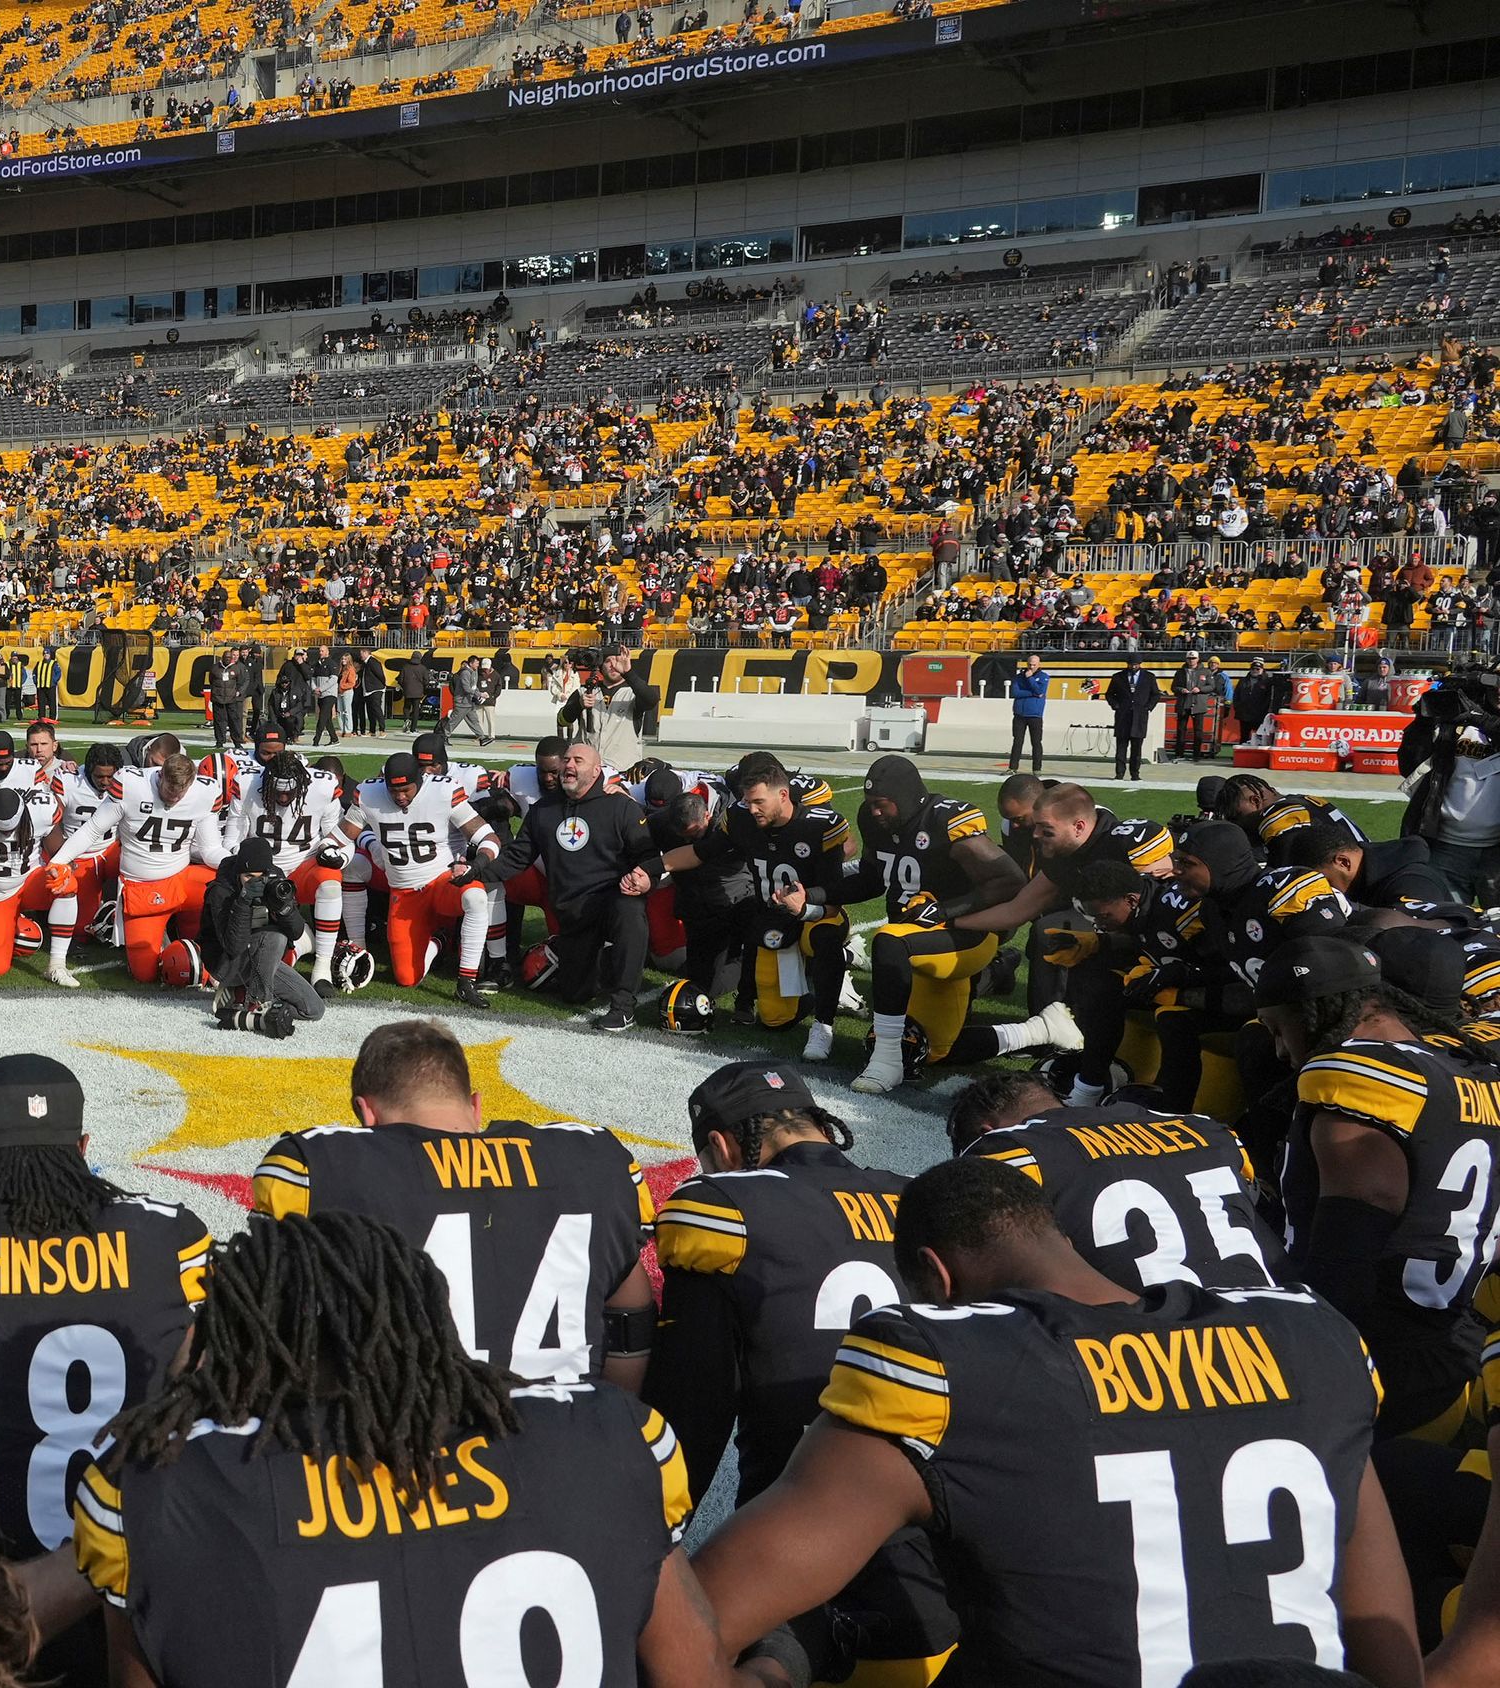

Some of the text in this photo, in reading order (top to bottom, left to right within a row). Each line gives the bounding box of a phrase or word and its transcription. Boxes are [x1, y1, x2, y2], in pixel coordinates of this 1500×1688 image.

[939, 19, 959, 30] BUILT
[939, 31, 960, 41] TOUGH
[507, 40, 826, 108] NeighborhoodFordStore.com
[868, 446, 879, 455] 90
[941, 479, 951, 489] 90
[1061, 467, 1072, 476] 90
[1196, 515, 1210, 526] 90
[1225, 514, 1237, 524] 39
[475, 577, 487, 587] 58
[645, 578, 656, 588] 16
[610, 614, 622, 624] 43
[628, 611, 635, 621] 3
[805, 806, 836, 821] 10
[136, 817, 193, 853] 47
[255, 814, 312, 855] 94
[378, 821, 437, 866] 56
[753, 858, 800, 909] 10
[876, 851, 922, 905] 79
[1067, 1118, 1212, 1162] MAULET
[423, 1136, 540, 1190] WATT
[1091, 1165, 1276, 1289] 35
[1073, 1324, 1290, 1415] BOYKIN
[297, 1434, 511, 1539] JONES
[1094, 1437, 1346, 1688] 13
